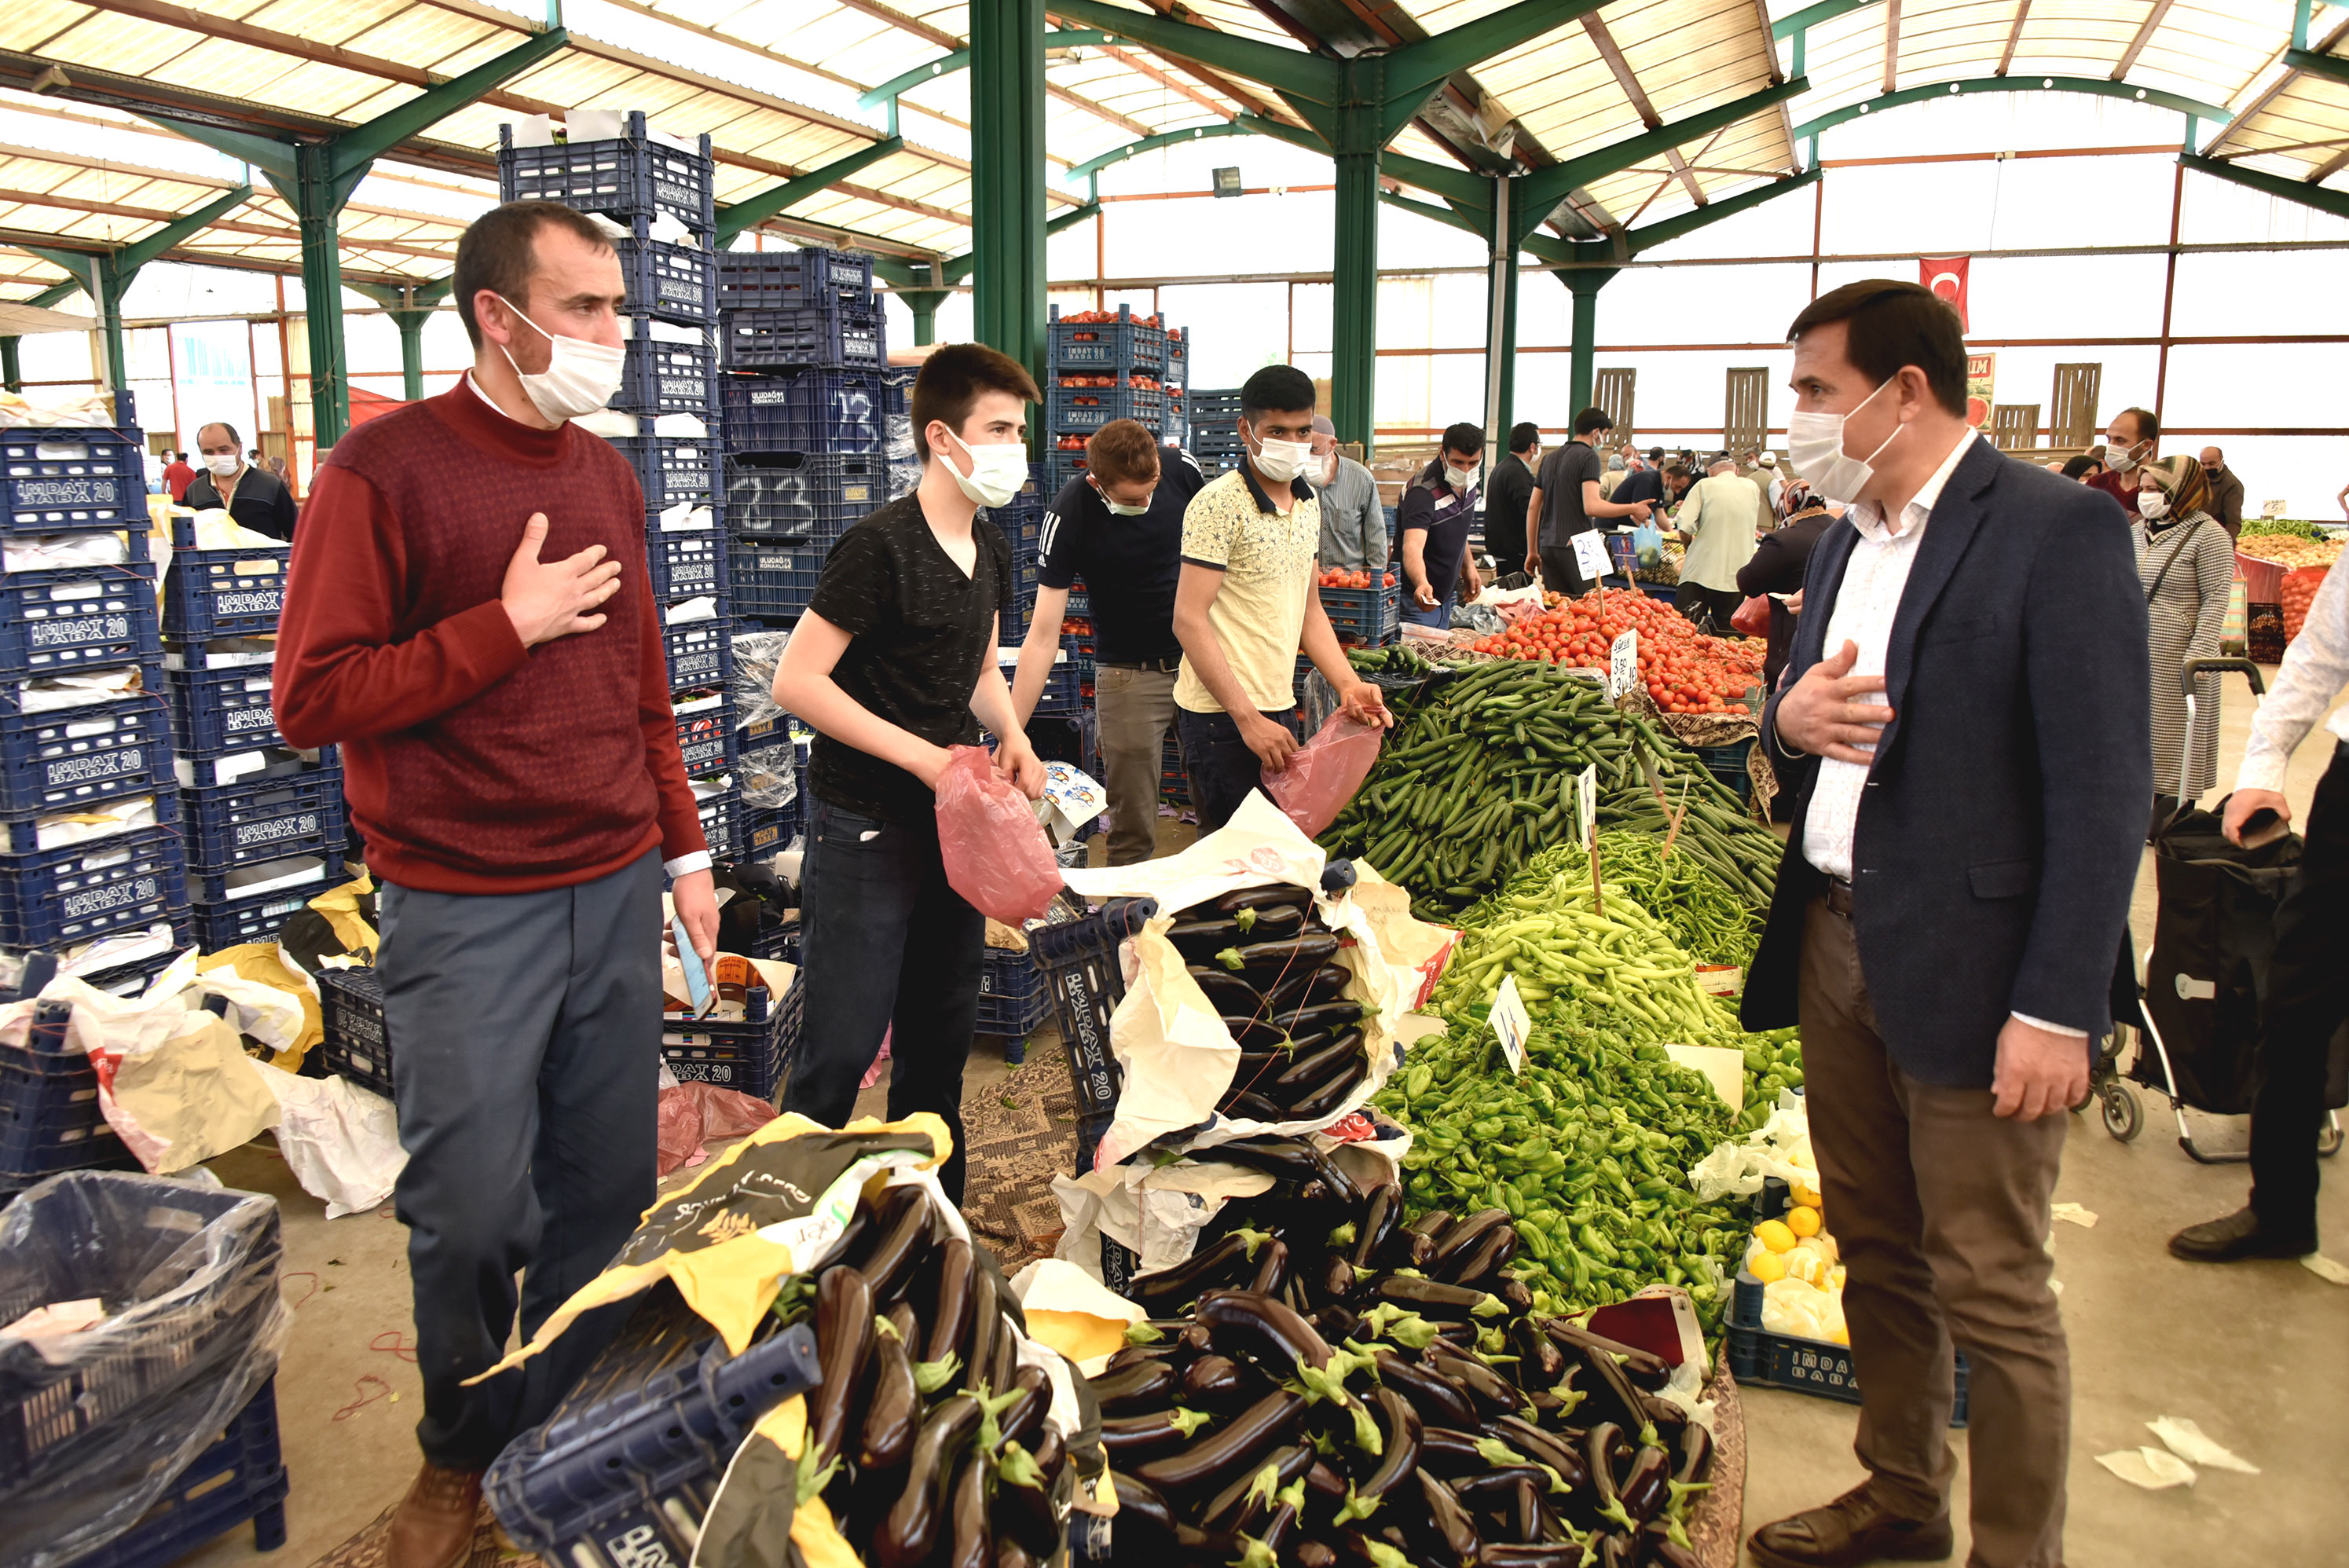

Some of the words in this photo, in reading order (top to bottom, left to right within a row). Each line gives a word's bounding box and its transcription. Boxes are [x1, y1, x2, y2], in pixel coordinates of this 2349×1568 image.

[1968, 359, 1988, 374] IM
[19, 493, 92, 505] BABA
[93, 482, 115, 502] 20
[218, 602, 280, 614] BABA
[106, 617, 127, 638] 20
[33, 630, 105, 647] BABA
[228, 708, 274, 723] İMDA
[228, 717, 277, 731] BAB
[121, 749, 141, 771] 20
[49, 764, 119, 785] BABA
[299, 815, 316, 833] 20
[237, 826, 297, 844] BABA
[135, 878, 156, 900] 20
[65, 894, 134, 918] BABA
[1065, 975, 1097, 1069] BABA
[669, 1064, 709, 1073] DAT
[712, 1065, 731, 1083] 20
[676, 1072, 709, 1081] BA
[1091, 1071, 1112, 1100] 20
[1792, 1351, 1849, 1375] İMDA
[1792, 1366, 1860, 1390] BABA
